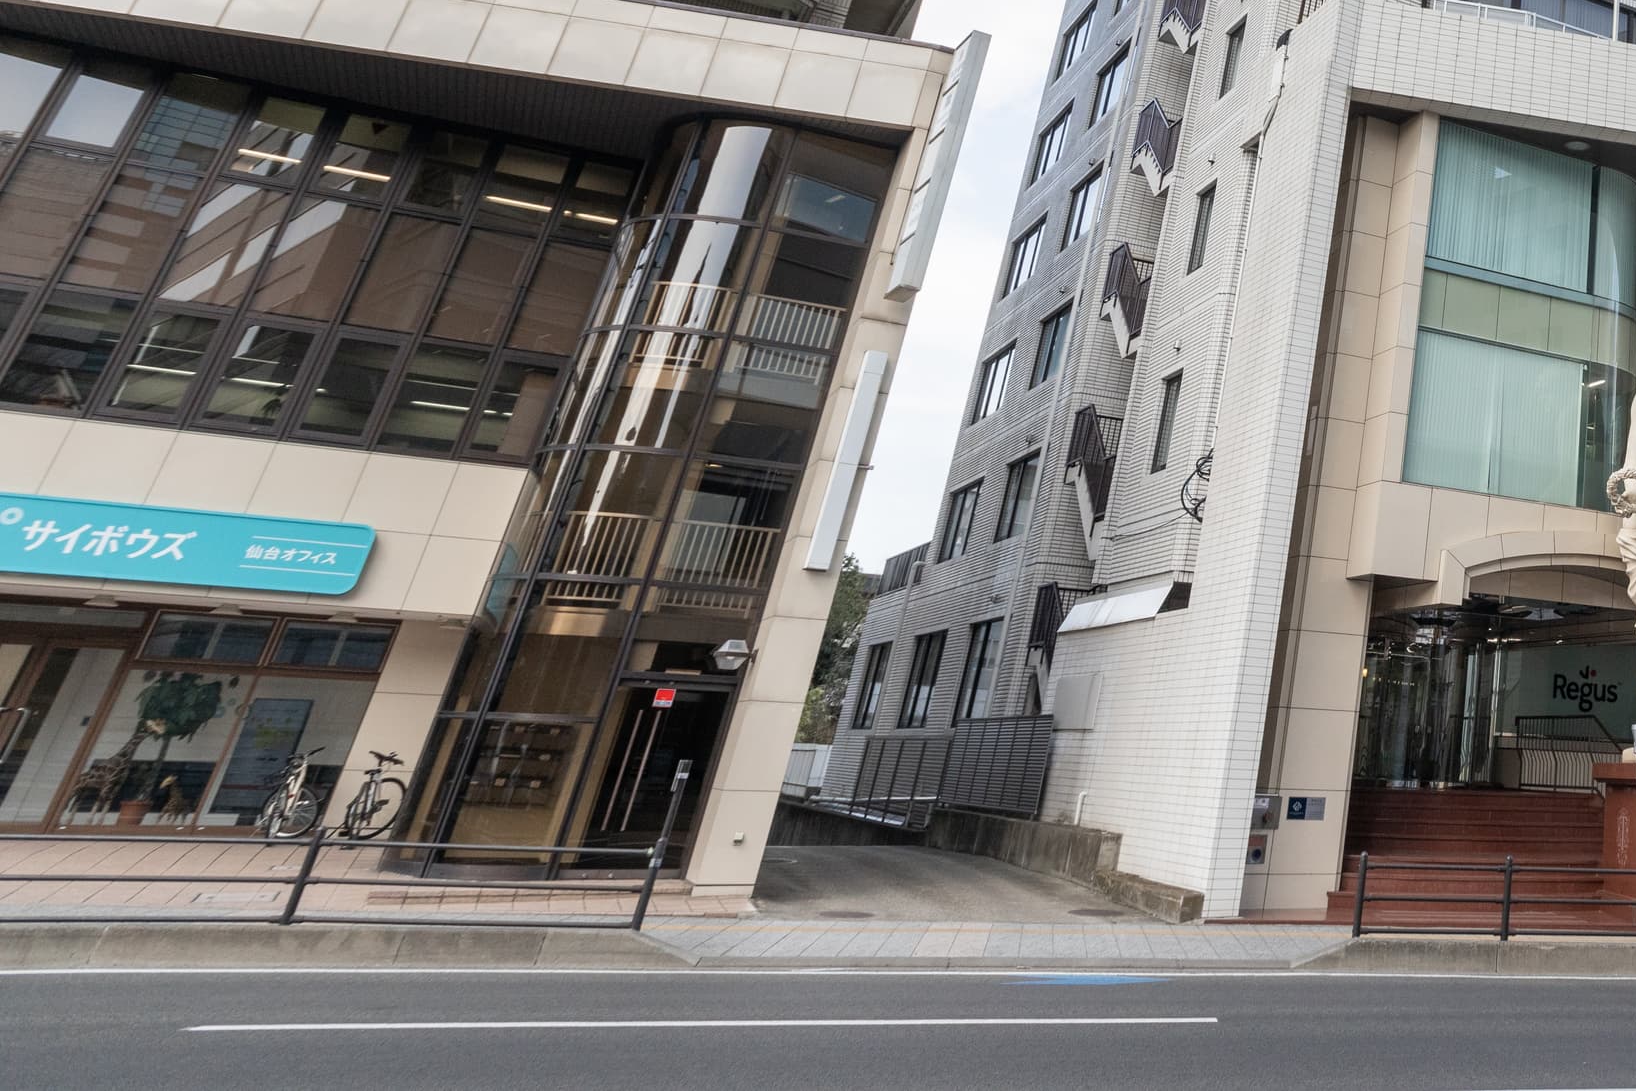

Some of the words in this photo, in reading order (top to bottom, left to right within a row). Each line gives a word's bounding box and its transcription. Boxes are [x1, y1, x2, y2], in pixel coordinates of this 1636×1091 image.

[22, 519, 199, 561] サイボウズ
[244, 543, 338, 566] 仙台オフィス
[1552, 674, 1619, 712] Regus
